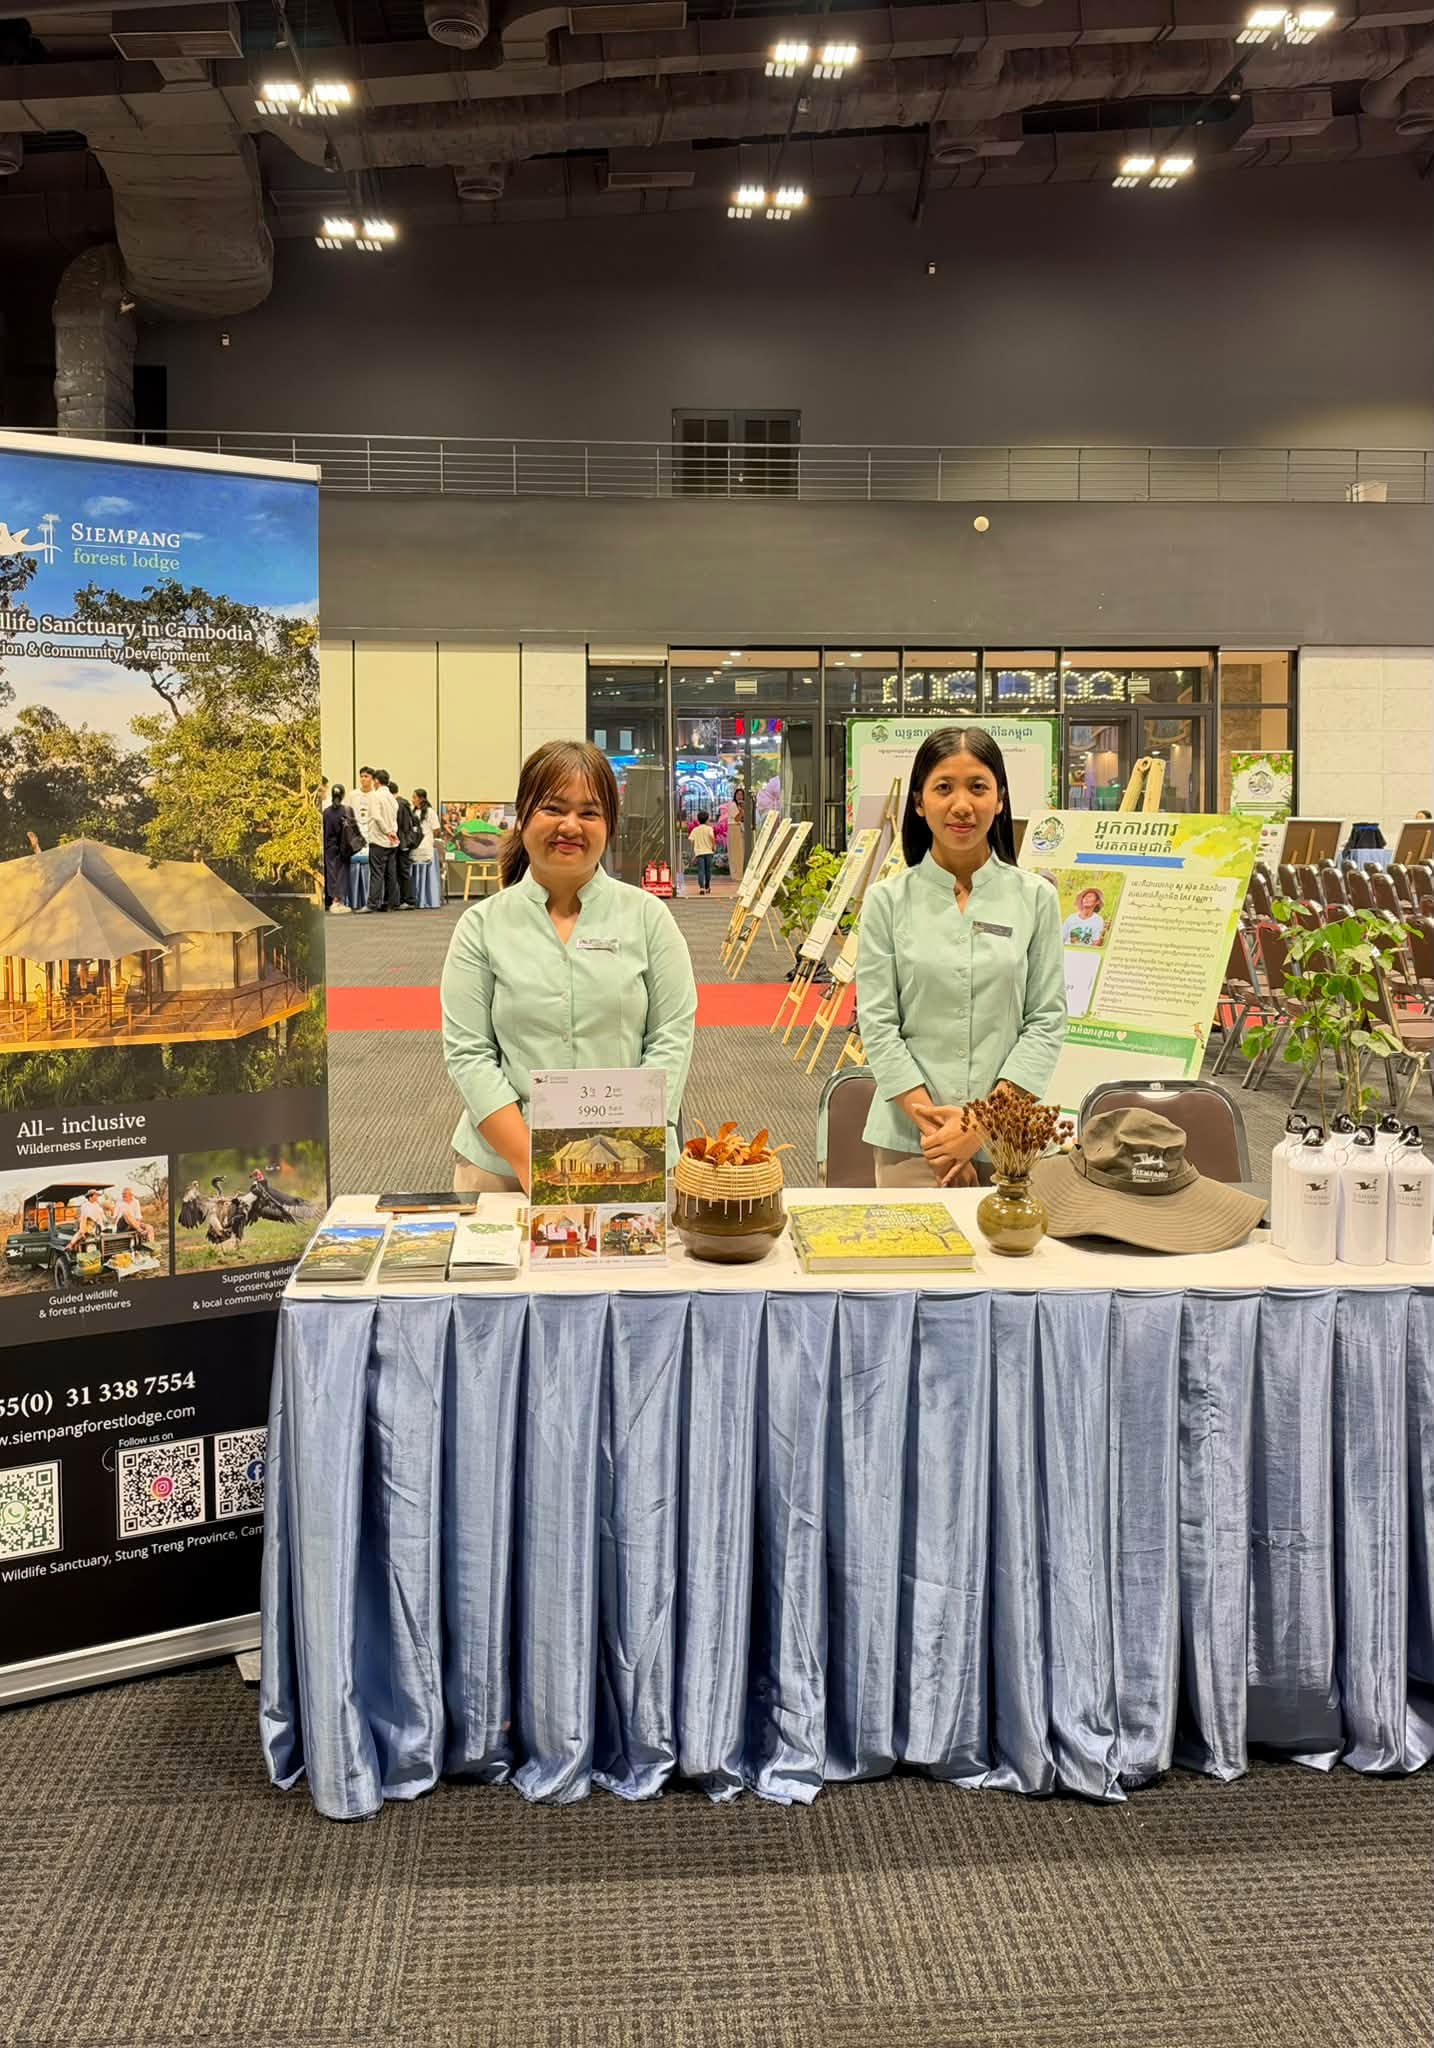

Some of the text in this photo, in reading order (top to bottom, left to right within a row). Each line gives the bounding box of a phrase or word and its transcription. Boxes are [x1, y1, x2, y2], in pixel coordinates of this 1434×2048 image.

[71, 523, 181, 549] SIEMPANG
[73, 550, 180, 573] forest lodge
[42, 615, 136, 638] Sanctuary
[142, 620, 160, 637] in
[164, 622, 253, 641] Cambodia
[27, 642, 39, 657] &
[42, 643, 124, 660] Community
[125, 647, 211, 663] Development
[578, 1104, 607, 1117] $990
[62, 1112, 147, 1135] inclusive
[16, 1134, 147, 1156] Wilderness Experience
[222, 1269, 271, 1284] Supporting
[49, 1288, 119, 1305] Guided wildlife
[192, 1301, 200, 1310] &
[202, 1299, 222, 1309] local
[224, 1291, 273, 1306] community
[39, 1300, 131, 1318] & forest adventures
[66, 1386, 92, 1407] 31
[99, 1380, 138, 1402] 338
[144, 1371, 196, 1395] 7554
[118, 1432, 174, 1448] Follow us on
[1, 1564, 47, 1583] Wildlife
[49, 1554, 112, 1574] Sanctuary,
[115, 1545, 149, 1562] Stung
[151, 1538, 185, 1555] Treng
[187, 1530, 238, 1547] Province,
